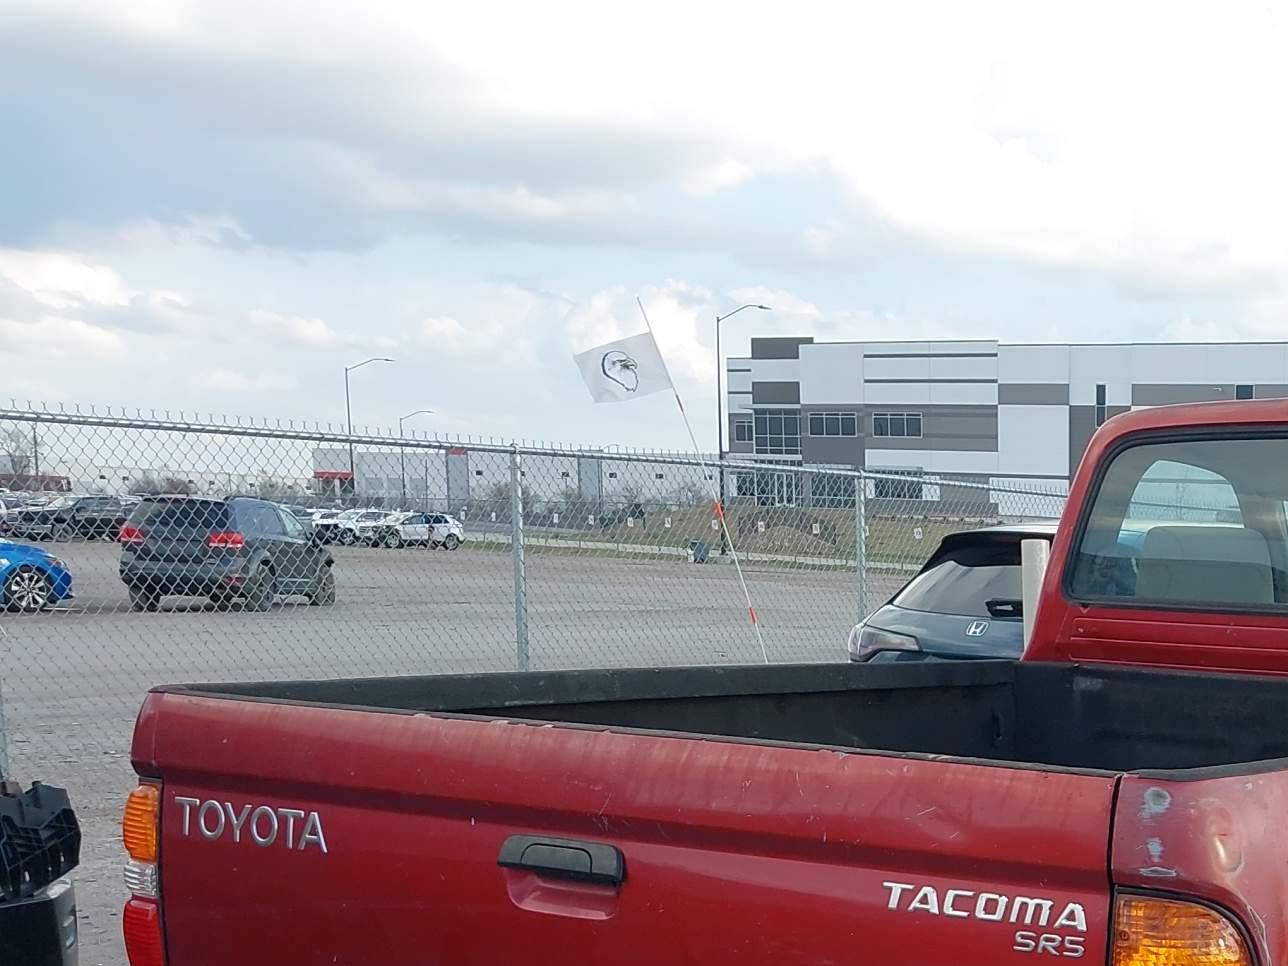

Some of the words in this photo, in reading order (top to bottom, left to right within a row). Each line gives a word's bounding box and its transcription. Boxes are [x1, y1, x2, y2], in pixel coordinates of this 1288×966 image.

[174, 796, 329, 854] TOYOTA
[882, 881, 1088, 932] TACOMA
[1012, 930, 1086, 958] SR5
